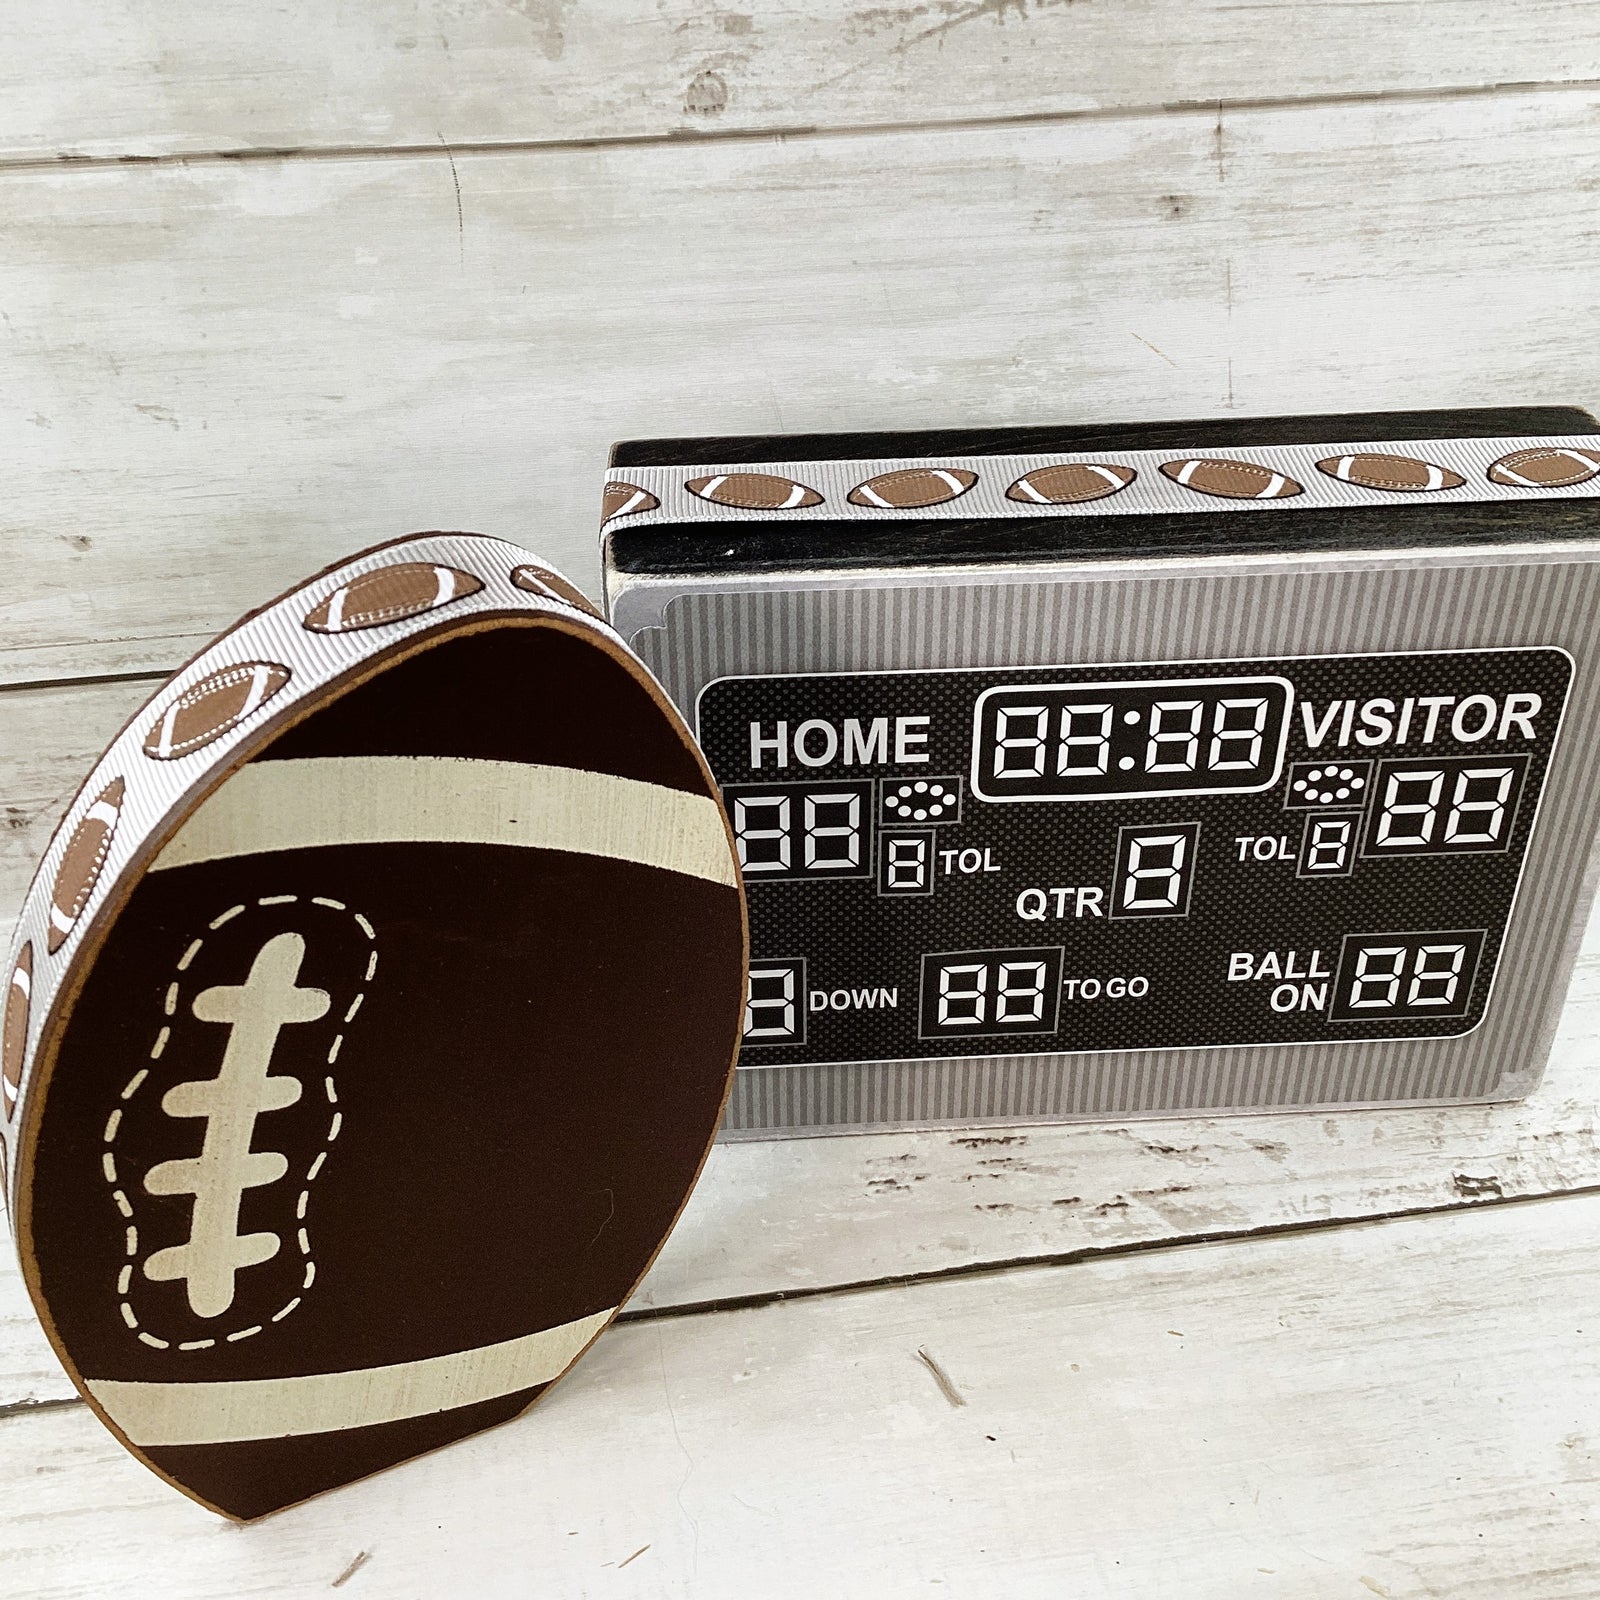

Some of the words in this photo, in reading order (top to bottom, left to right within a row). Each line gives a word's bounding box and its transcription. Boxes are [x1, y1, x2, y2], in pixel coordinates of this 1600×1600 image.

[1299, 693, 1542, 748] VISITOR
[749, 715, 931, 769] HOME
[938, 847, 1001, 875] TOL
[1235, 835, 1296, 862] TOL
[1015, 886, 1103, 922] QTR
[1227, 949, 1331, 981] BALL
[809, 987, 898, 1012] DOWN
[1063, 978, 1101, 1000] TO
[1105, 976, 1149, 998] GO
[1269, 982, 1329, 1013] ON
